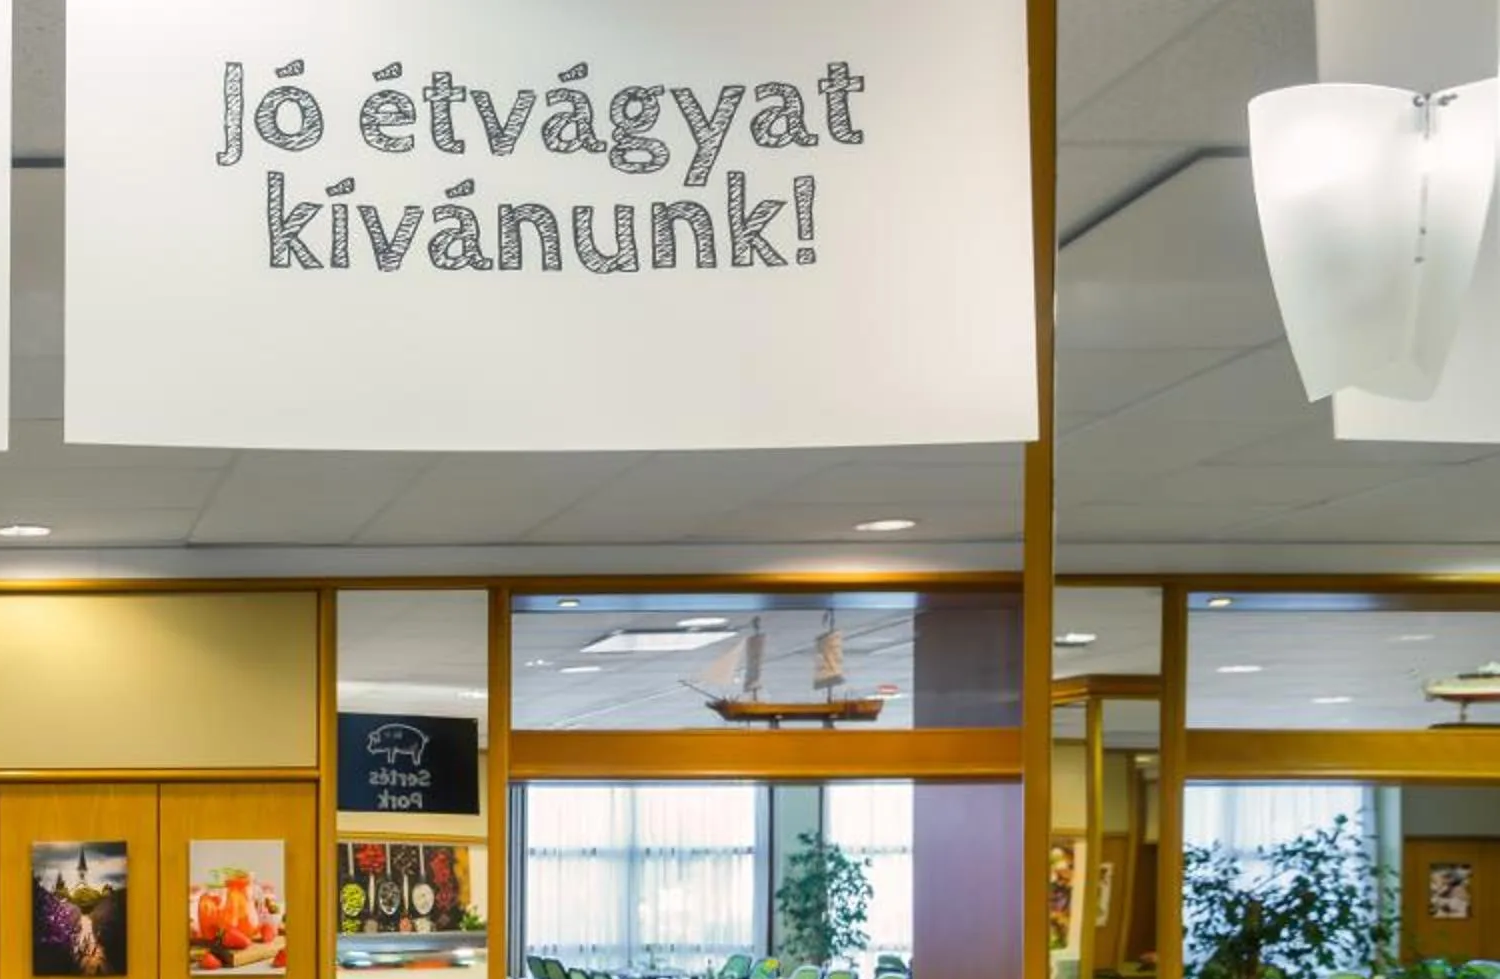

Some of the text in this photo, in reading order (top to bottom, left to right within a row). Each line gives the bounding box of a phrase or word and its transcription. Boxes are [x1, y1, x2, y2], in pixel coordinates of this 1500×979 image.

[217, 60, 864, 187] Jó étvágyat
[267, 171, 816, 273] kívánunk!
